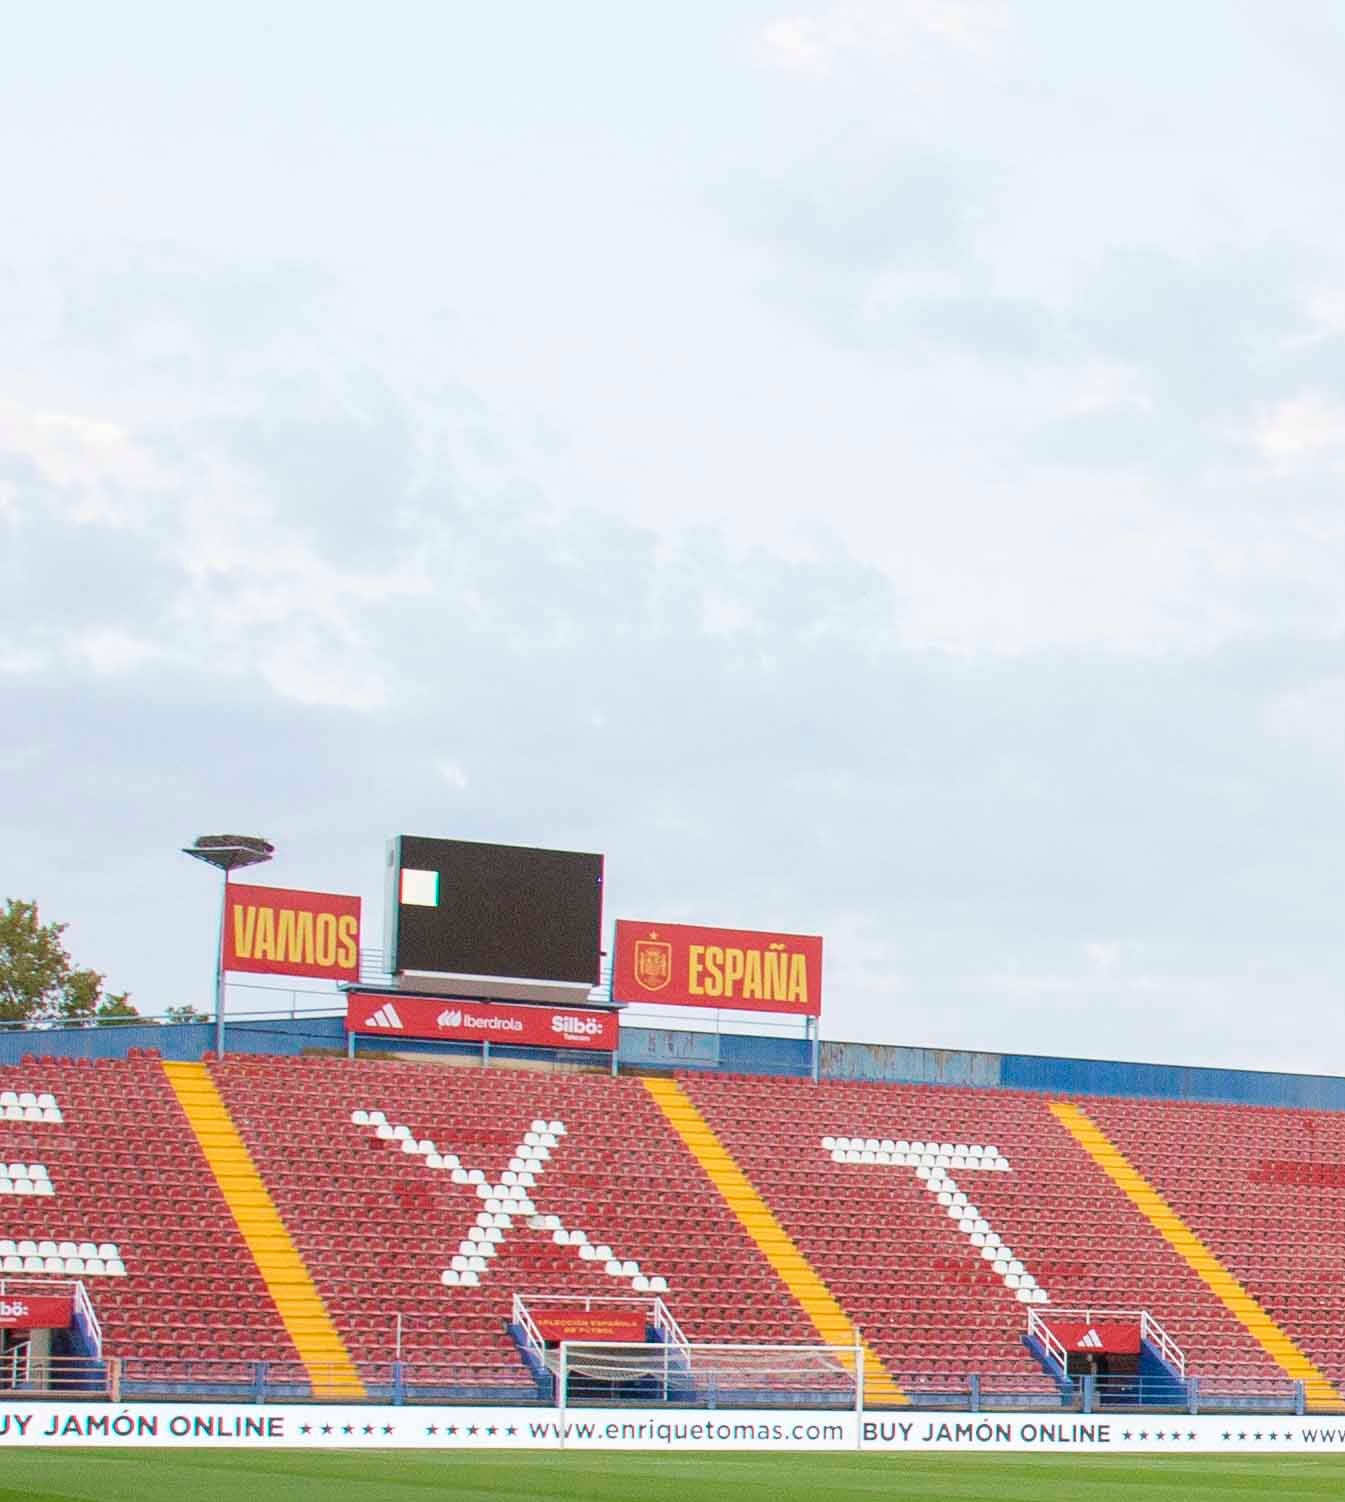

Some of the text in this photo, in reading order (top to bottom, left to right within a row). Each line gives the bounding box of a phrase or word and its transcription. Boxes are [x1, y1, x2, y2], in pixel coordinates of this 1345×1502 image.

[233, 904, 358, 969] VAMOS
[688, 942, 808, 1003] ESPAÑA
[464, 1015, 523, 1032] Iberdrola
[44, 1409, 158, 1437] JAMÓN
[169, 1415, 284, 1438] ONLINE
[529, 1419, 843, 1444] www.enriquetomas.com
[863, 1417, 1111, 1444] BUY JAMÓN ONLINE
